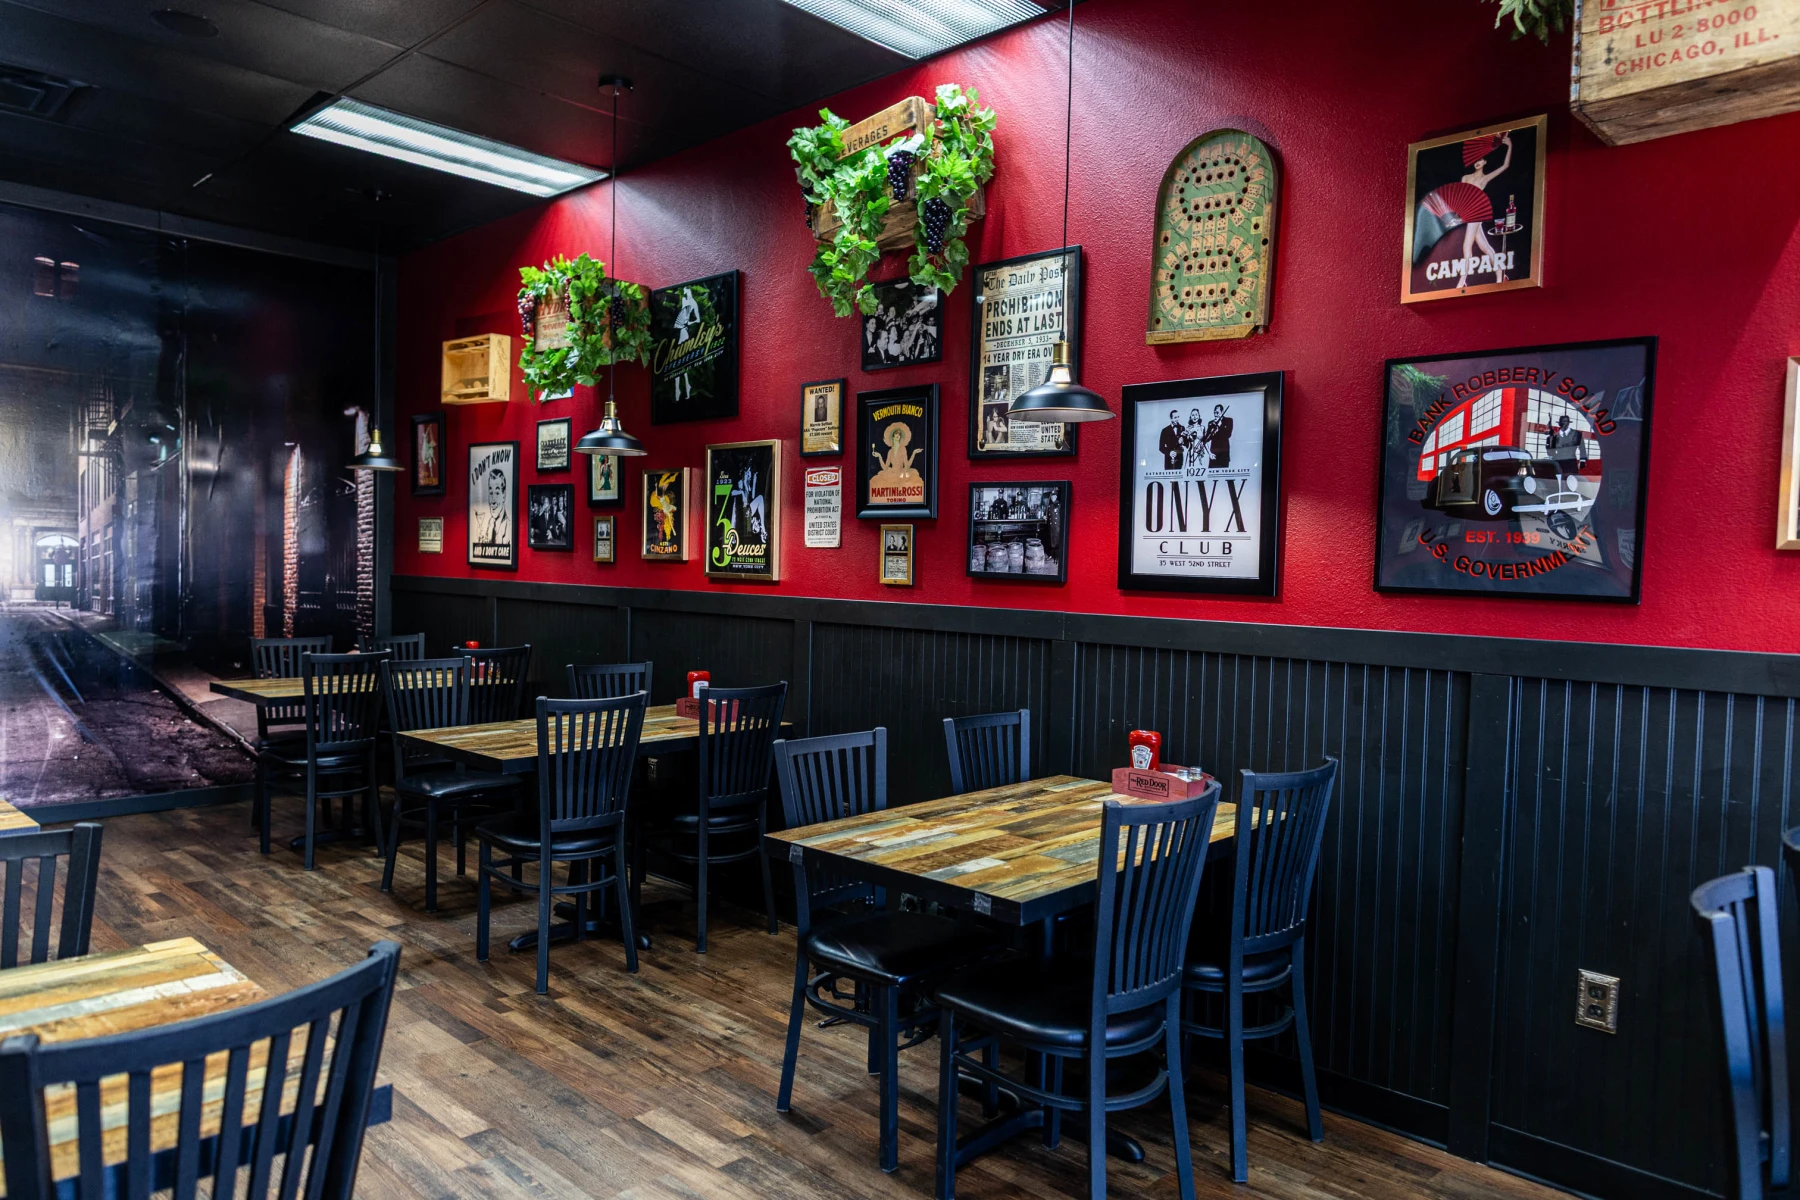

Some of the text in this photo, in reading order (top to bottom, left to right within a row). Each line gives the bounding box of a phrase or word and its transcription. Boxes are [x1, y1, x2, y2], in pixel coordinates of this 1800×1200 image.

[1599, 0, 1731, 36] BOTTLI
[1636, 5, 1758, 49] LU 2-8000
[1614, 27, 1780, 77] CHICAGO, ILL.
[837, 125, 888, 158] EVERAGES
[1426, 251, 1515, 281] CAMPARI
[987, 277, 1005, 291] The
[1008, 270, 1035, 287] Daily
[986, 290, 1062, 319] PROHIBITION
[985, 311, 1062, 338] ENDS AT LAST
[654, 314, 724, 374] Chumley's
[984, 354, 991, 364] 14
[993, 352, 1010, 363] YEAR
[1012, 350, 1025, 361] DRY
[1027, 348, 1040, 359] ERA
[809, 386, 835, 395] WANTED!
[873, 404, 923, 421] VERMOUTH BIANCO
[1407, 366, 1618, 445] BANK ROBBERY SQUAD
[1041, 425, 1061, 434] UNITED
[474, 455, 490, 481] DON'T
[492, 449, 511, 465] KNOW
[1186, 467, 1206, 477] 1927
[1145, 478, 1248, 533] ONYX
[650, 543, 678, 554] CINZANO
[722, 529, 766, 555] Deuces
[1159, 541, 1233, 555] CLUB
[1418, 528, 1448, 564] U.S.
[1465, 531, 1541, 544] EST. 1939
[498, 546, 510, 557] CARE
[1149, 778, 1167, 791] DOOR
